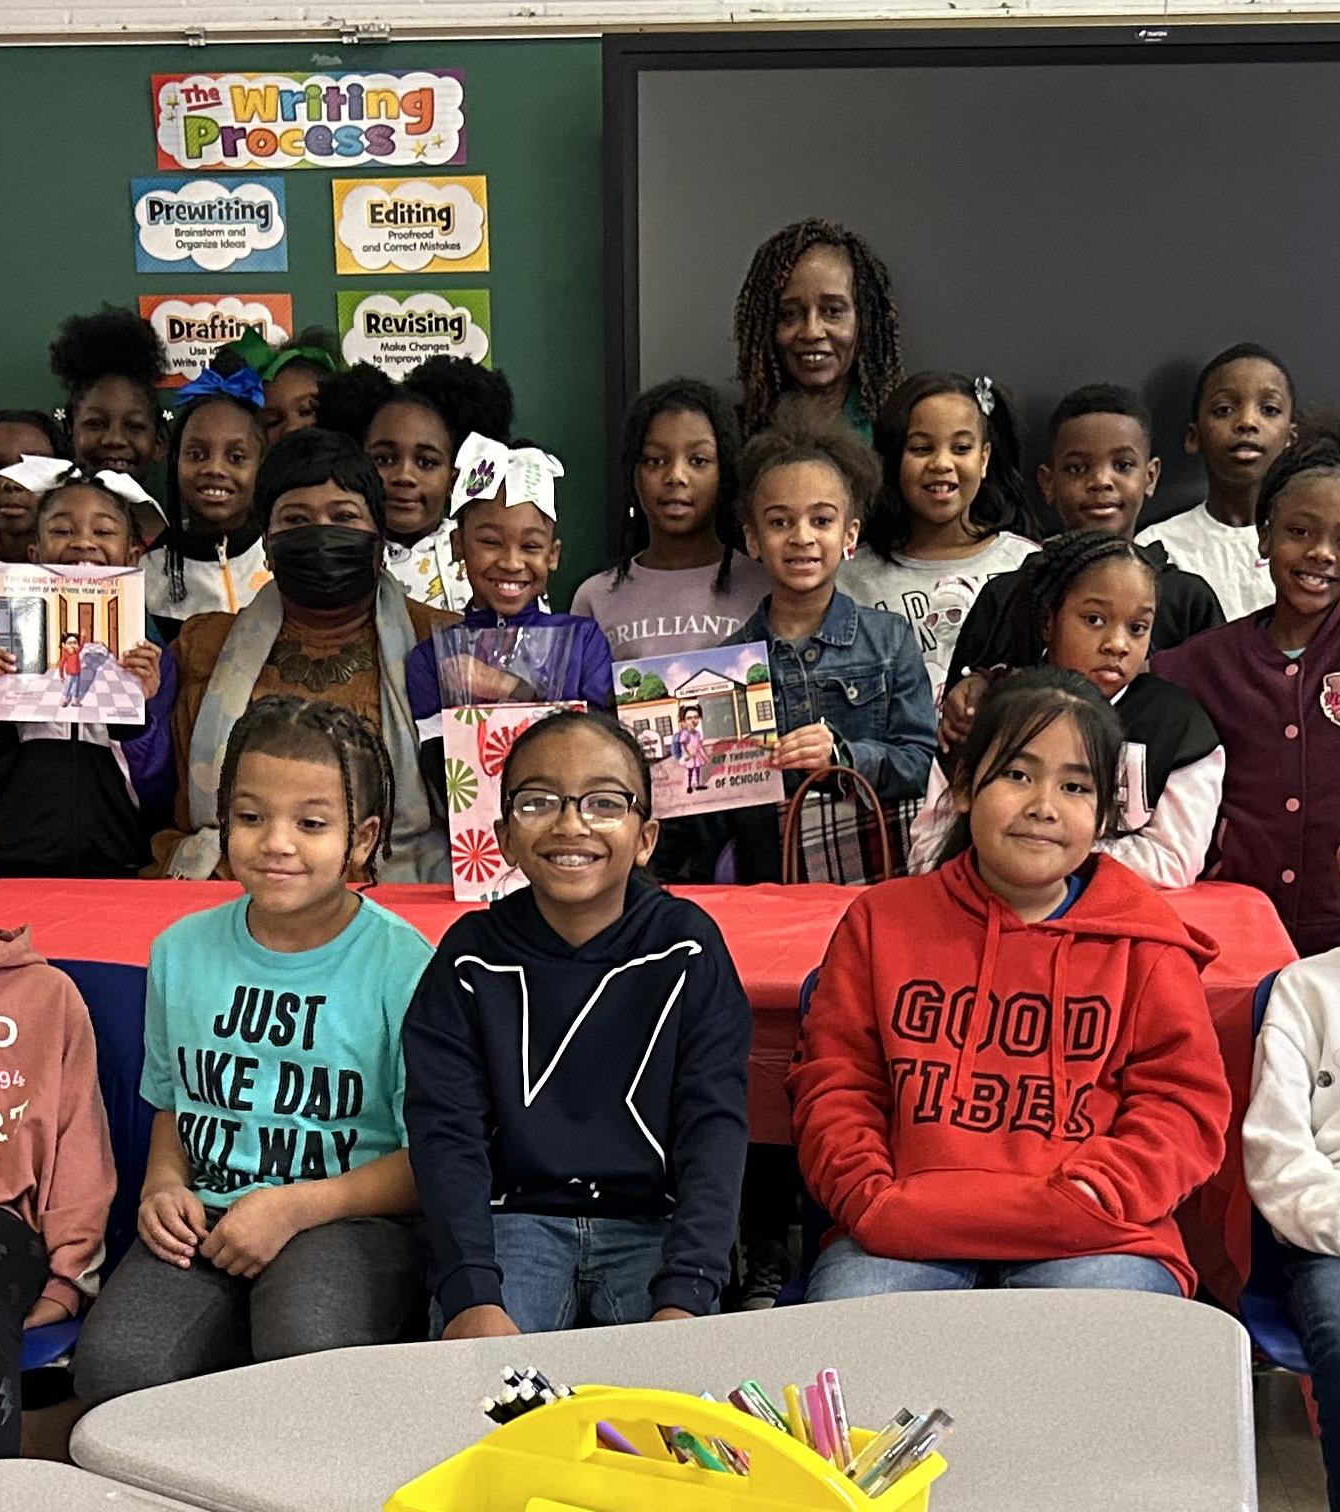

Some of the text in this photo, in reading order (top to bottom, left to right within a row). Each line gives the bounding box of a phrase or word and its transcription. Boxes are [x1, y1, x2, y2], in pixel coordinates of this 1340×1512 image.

[180, 82, 435, 135] The Writing
[183, 114, 396, 159] Process
[148, 199, 271, 229] Prewriting
[369, 201, 452, 232] Editing
[174, 227, 246, 238] Brainstorm and
[388, 229, 434, 240] Proofread
[175, 239, 218, 251] Organize
[362, 240, 461, 252] and Correct Mistakes
[366, 313, 463, 341] Revising
[189, 346, 207, 356] Use
[373, 354, 383, 364] to
[384, 354, 422, 365] Improve
[380, 342, 450, 354] Make Changes
[172, 358, 197, 368] Write
[715, 770, 771, 789] OF SCHOOL?
[213, 985, 327, 1050] JUST
[891, 979, 1111, 1061] GOOD
[177, 1046, 364, 1122] LIKE DAD
[258, 1127, 358, 1181] WAY
